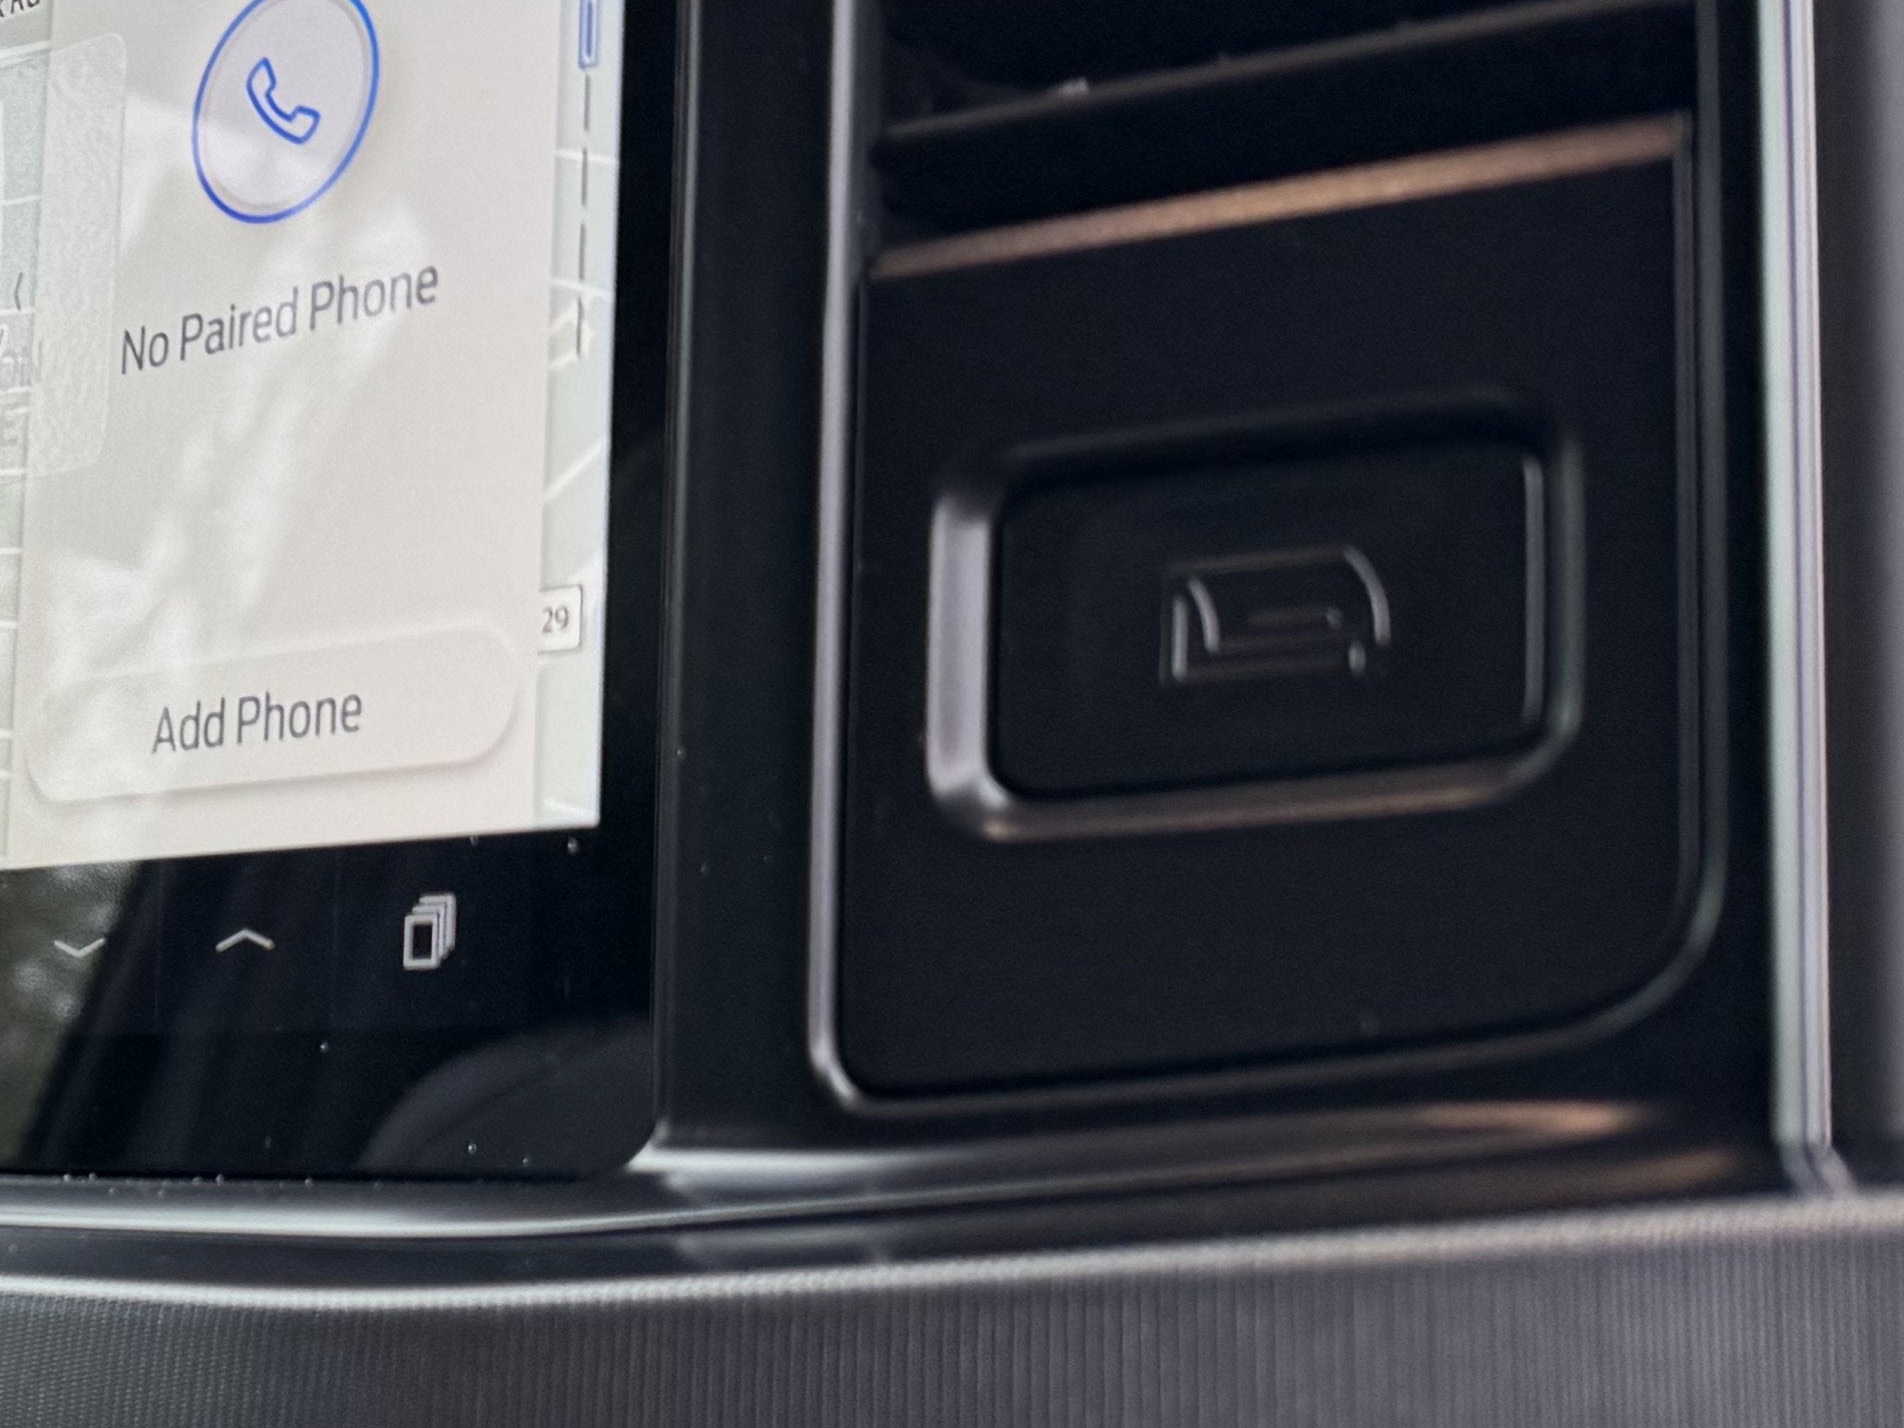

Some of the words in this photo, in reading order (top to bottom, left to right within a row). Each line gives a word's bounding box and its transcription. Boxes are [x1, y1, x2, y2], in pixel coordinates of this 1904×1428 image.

[121, 325, 168, 375] No
[180, 287, 297, 361] Paired
[309, 265, 438, 331] Phone
[152, 698, 225, 755] Add
[236, 689, 362, 744] Phone
